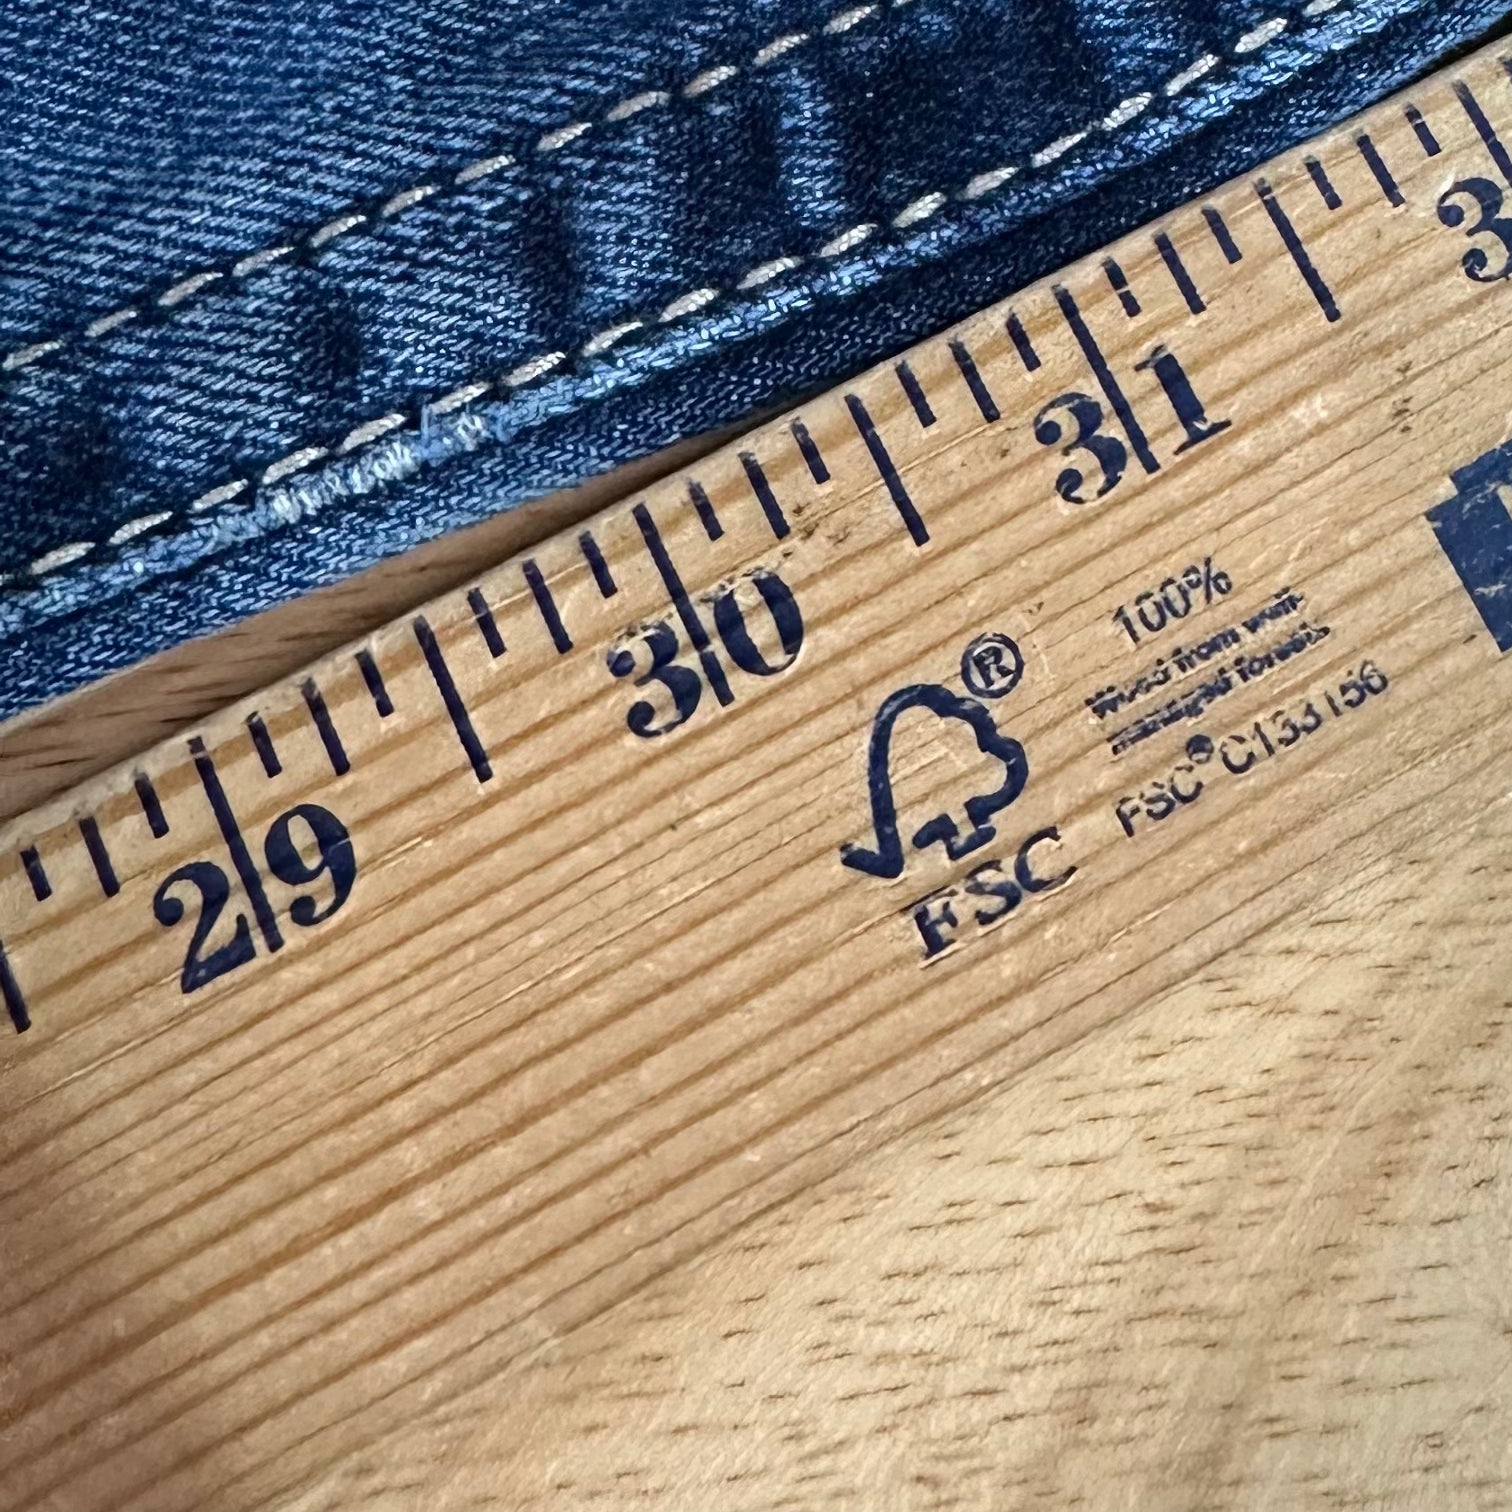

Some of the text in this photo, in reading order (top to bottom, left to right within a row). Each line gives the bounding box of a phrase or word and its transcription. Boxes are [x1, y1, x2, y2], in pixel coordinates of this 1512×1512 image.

[1032, 343, 1234, 505] 31
[605, 565, 806, 739] 30
[1111, 555, 1233, 646] 100%
[152, 802, 358, 995] 29
[898, 826, 1079, 958] FSC
